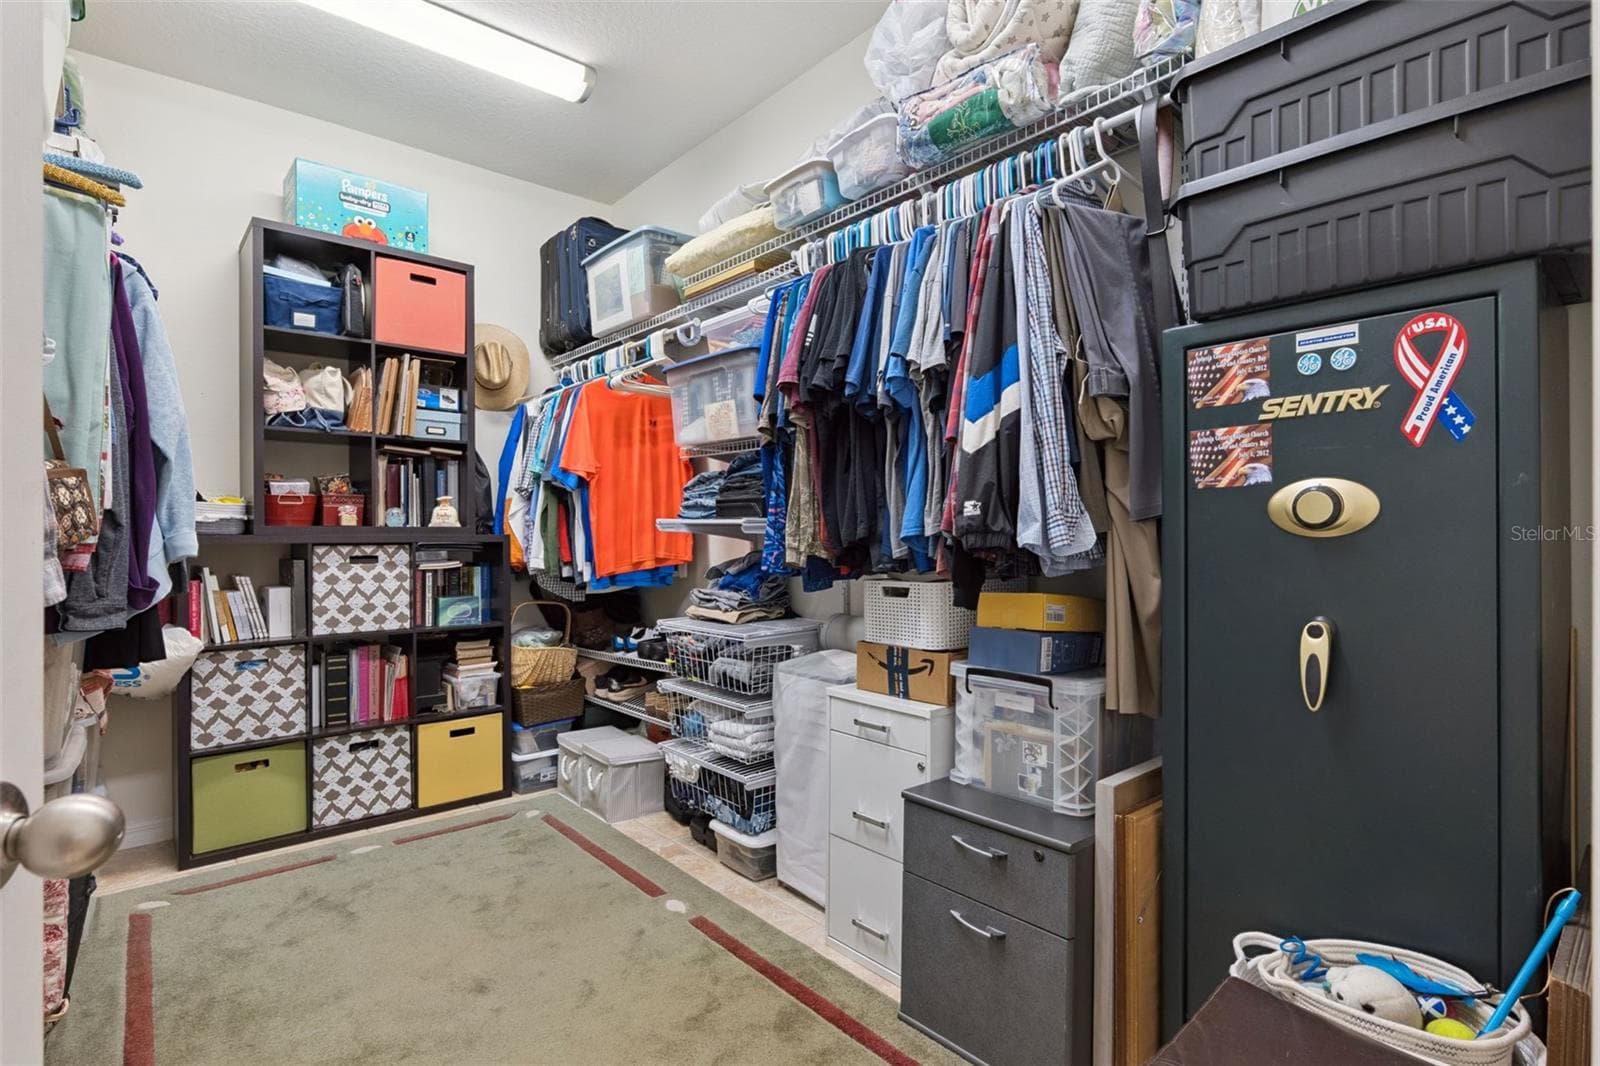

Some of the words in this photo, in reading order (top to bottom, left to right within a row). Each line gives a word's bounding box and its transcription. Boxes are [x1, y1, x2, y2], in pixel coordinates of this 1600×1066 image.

[342, 179, 388, 202] Pampers
[1411, 317, 1448, 332] USA
[1415, 395, 1436, 421] Proud
[1430, 352, 1458, 394] American
[1258, 384, 1390, 420] SENTRY
